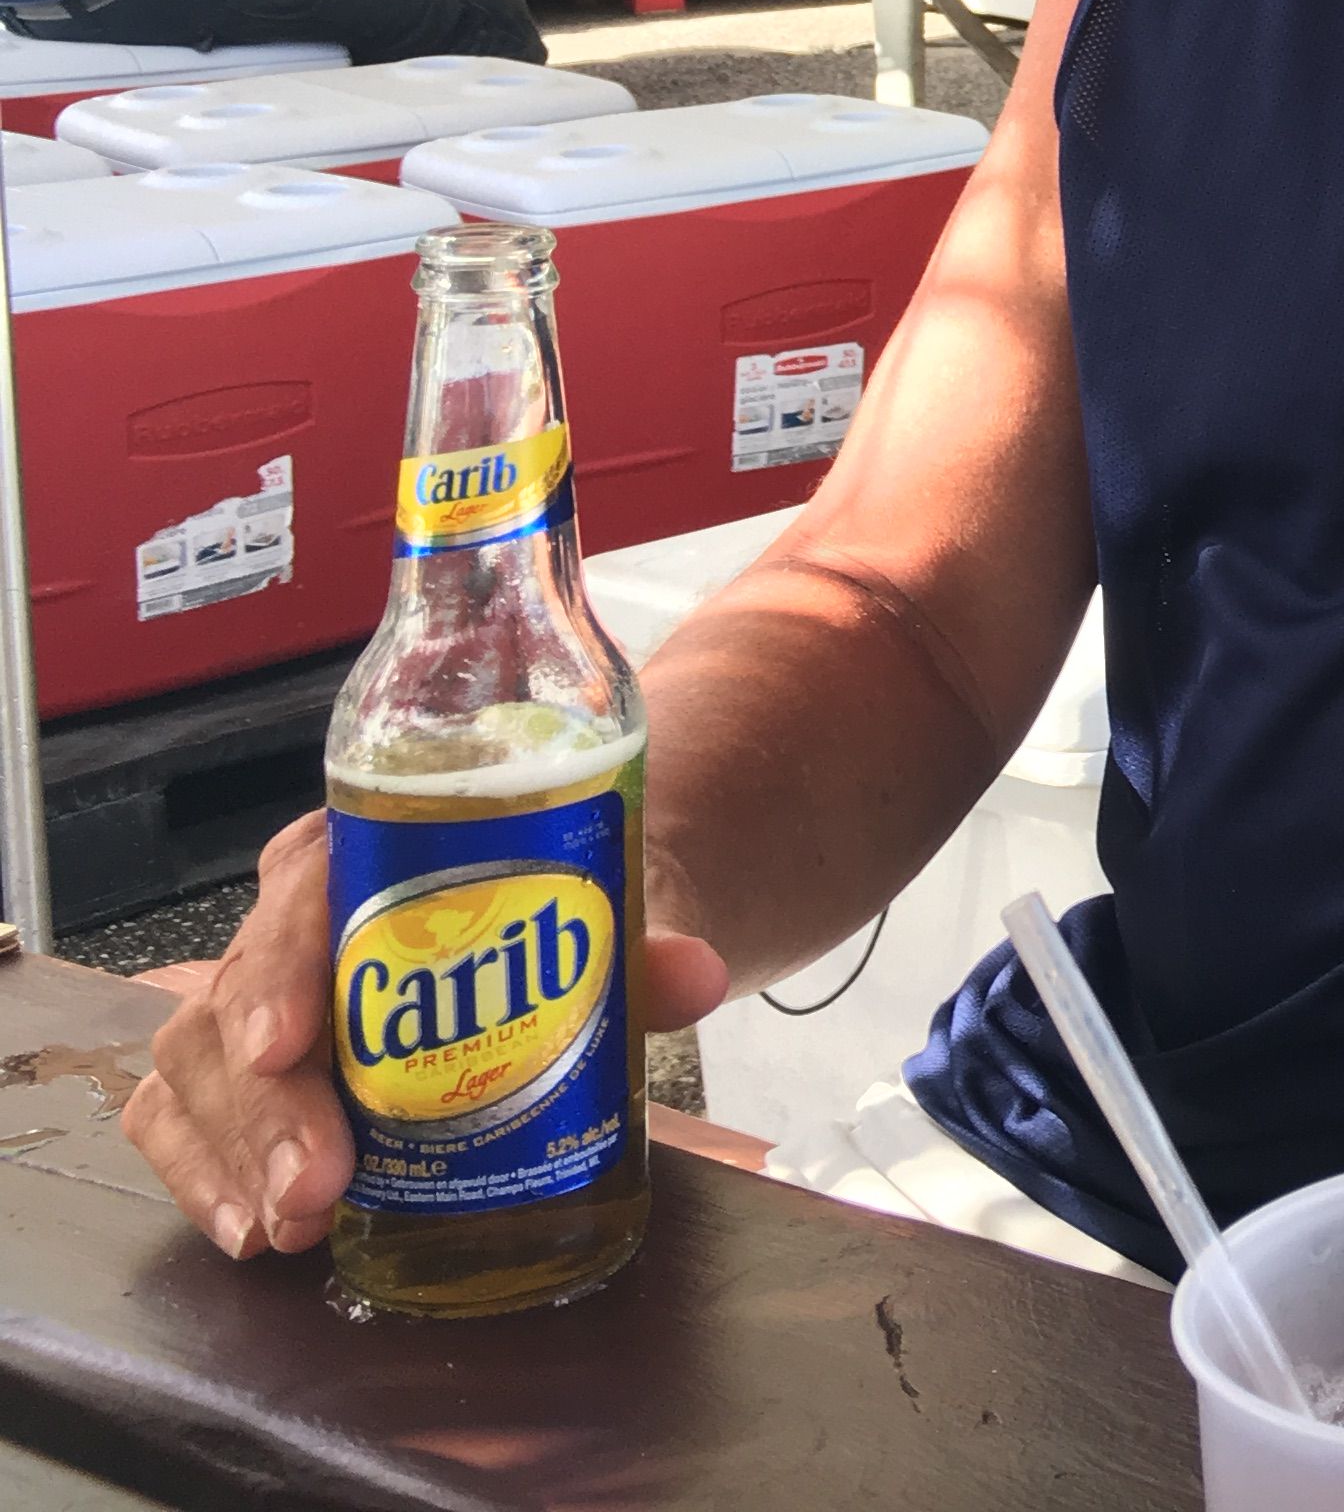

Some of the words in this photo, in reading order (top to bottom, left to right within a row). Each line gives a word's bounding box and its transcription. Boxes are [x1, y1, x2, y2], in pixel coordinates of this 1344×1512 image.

[415, 453, 517, 506] Carib
[348, 897, 591, 1067] Carib
[404, 1014, 538, 1074] PREMIUM
[440, 1061, 512, 1104] Lager
